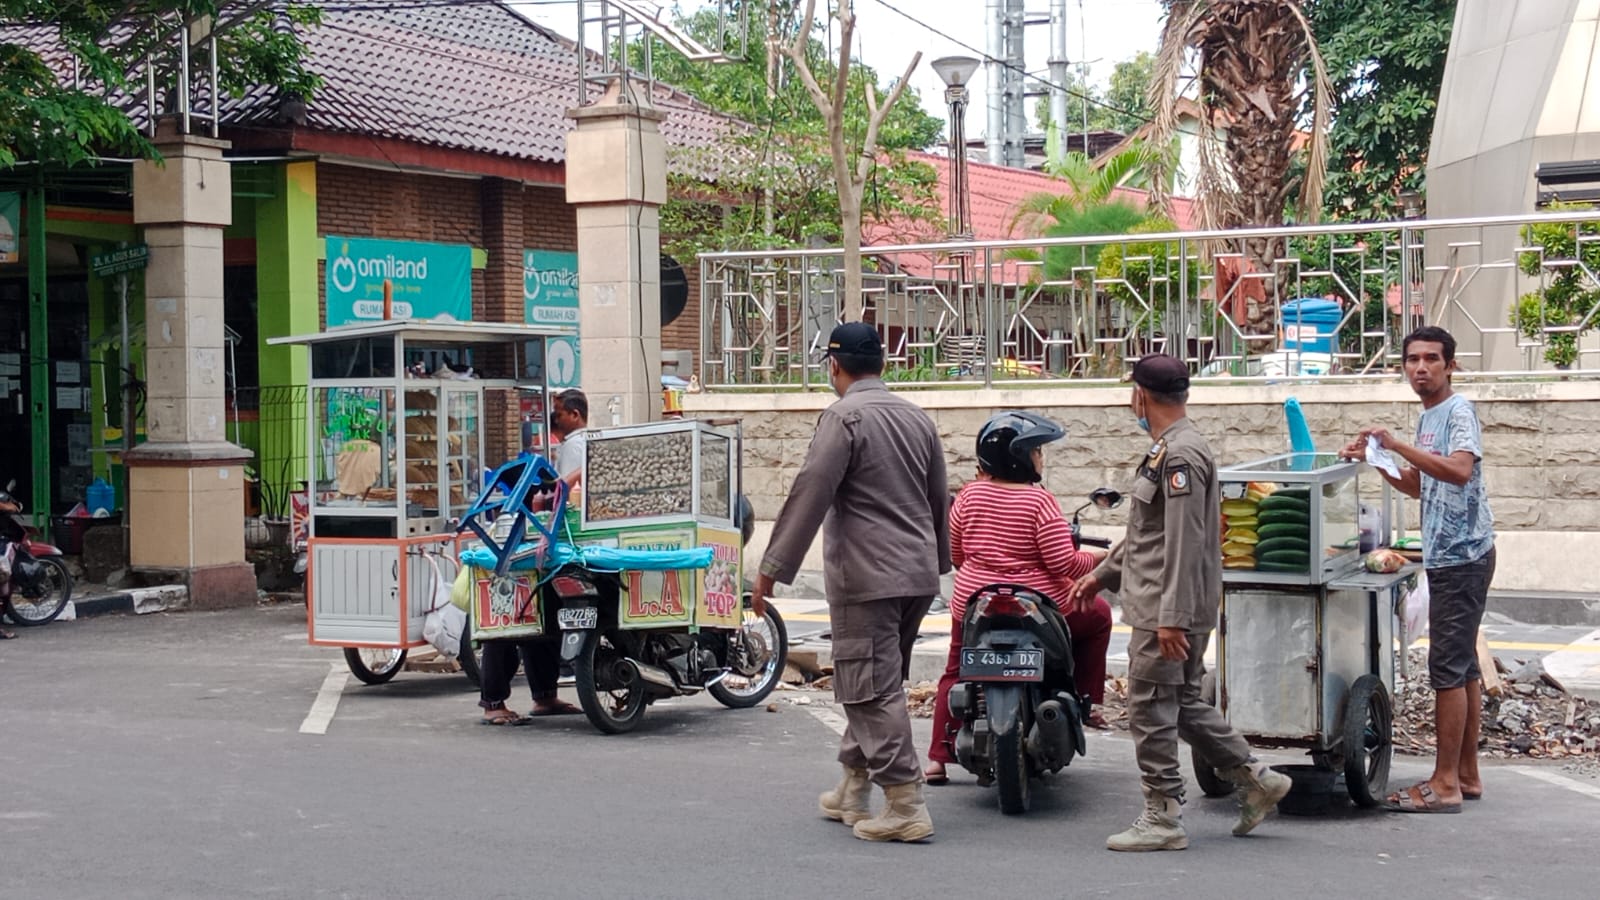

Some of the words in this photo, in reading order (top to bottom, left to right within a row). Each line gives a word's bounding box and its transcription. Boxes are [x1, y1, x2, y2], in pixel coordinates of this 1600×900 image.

[705, 592, 737, 618] TOP
[967, 653, 975, 665] S
[1020, 653, 1036, 666] DX
